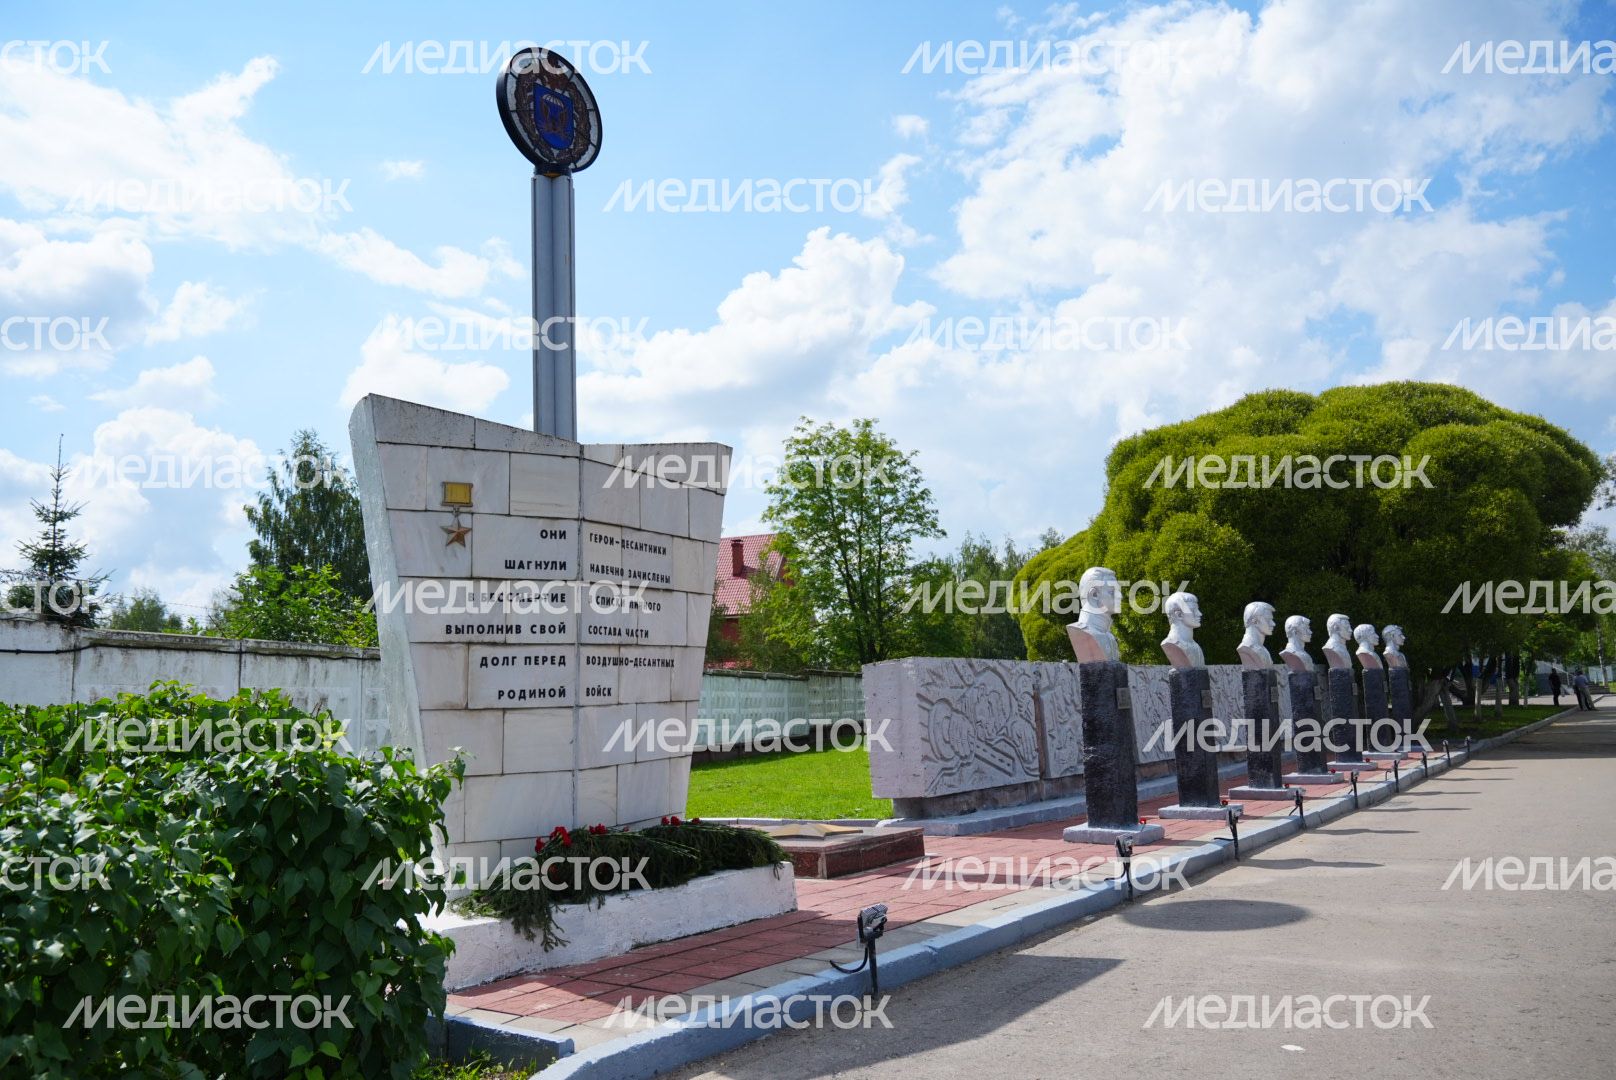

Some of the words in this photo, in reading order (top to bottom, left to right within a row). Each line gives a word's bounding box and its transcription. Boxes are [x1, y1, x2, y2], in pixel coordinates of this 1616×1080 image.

[540, 529, 567, 540] ОНИ
[589, 532, 667, 556] ГЕРОИ-ДЕСАНТНИКИ
[504, 559, 567, 571] ШАГНУЛИ
[590, 563, 624, 578] НАВЕЧНО
[628, 569, 671, 584] ЗАЧИСЛЕНЫ
[445, 624, 522, 635] ВЫПОЛНИВ
[530, 622, 566, 635] СВОЙ
[588, 625, 622, 637] СОСТАВА
[625, 628, 649, 639] ЧАСТИ
[480, 656, 518, 668] ДОЛГ
[524, 655, 566, 667] ПЕРЕД
[586, 655, 675, 668] ВОЗДУШНО-ДЕСАНТНЫХ
[497, 685, 566, 701] РОДИНОЙ
[586, 684, 612, 697] ВОЙСК
